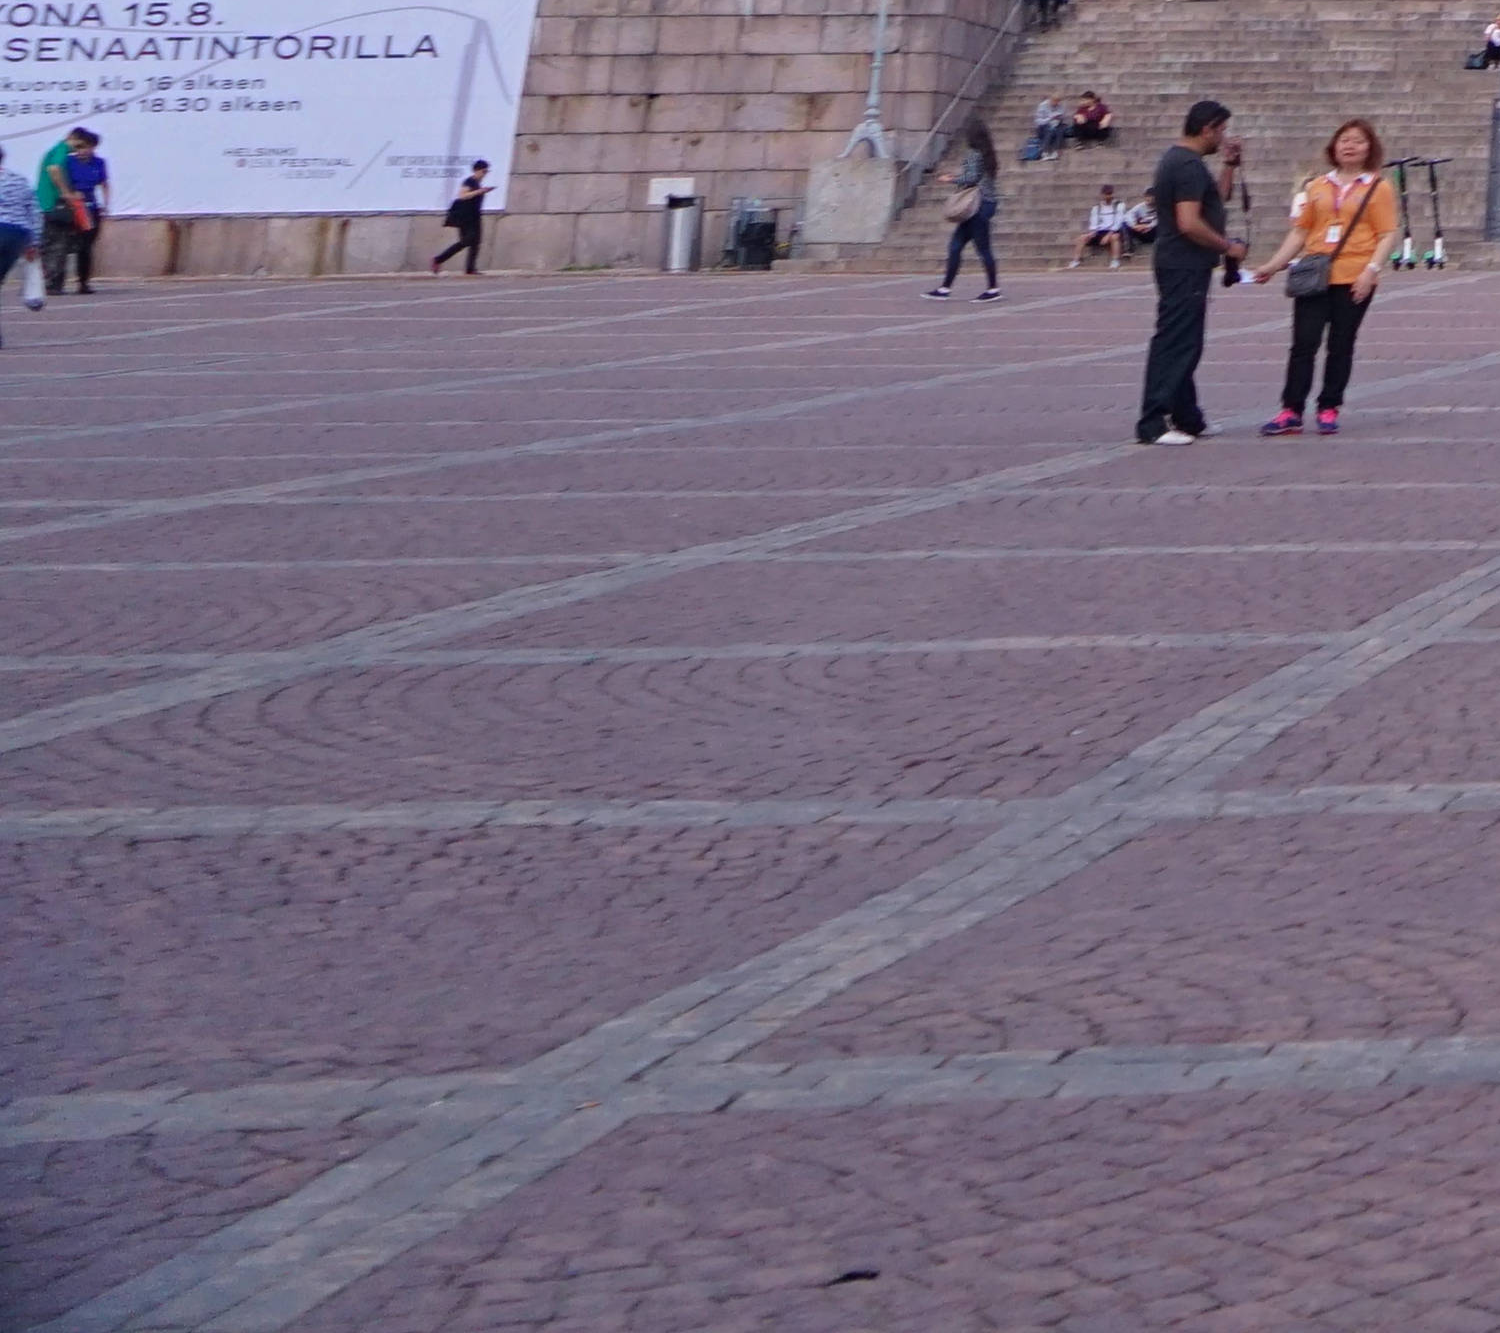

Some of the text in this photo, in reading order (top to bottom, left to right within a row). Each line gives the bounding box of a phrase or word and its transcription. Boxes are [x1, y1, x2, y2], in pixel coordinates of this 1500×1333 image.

[123, 2, 224, 27] 15.8.
[3, 35, 440, 61] SENAATINTORILLA
[99, 76, 136, 91] klo
[183, 76, 266, 91] alkaen
[138, 97, 210, 113] 18.30
[219, 97, 303, 113] alkaen
